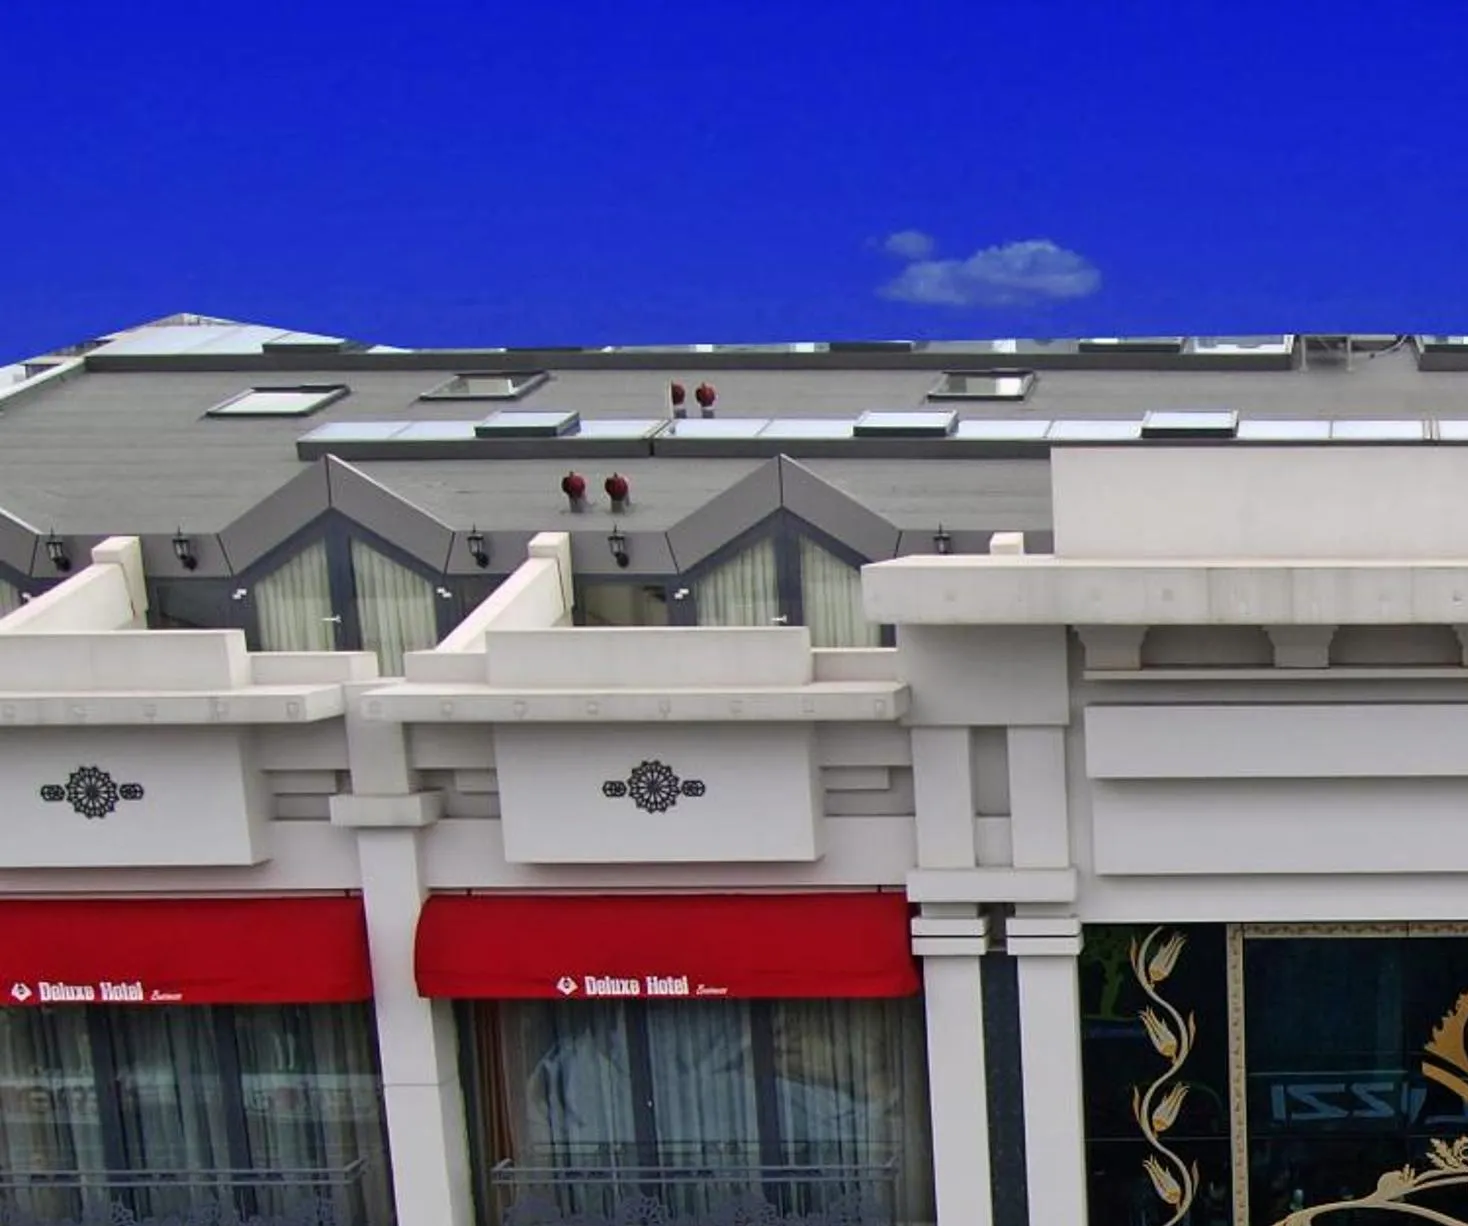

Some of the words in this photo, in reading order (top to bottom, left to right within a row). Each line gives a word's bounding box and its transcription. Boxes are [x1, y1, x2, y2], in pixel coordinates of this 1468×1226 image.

[38, 981, 95, 1001] Deluxe
[99, 980, 144, 1001] Hotel
[584, 975, 640, 995] Deluxe
[645, 975, 689, 995] Hotel
